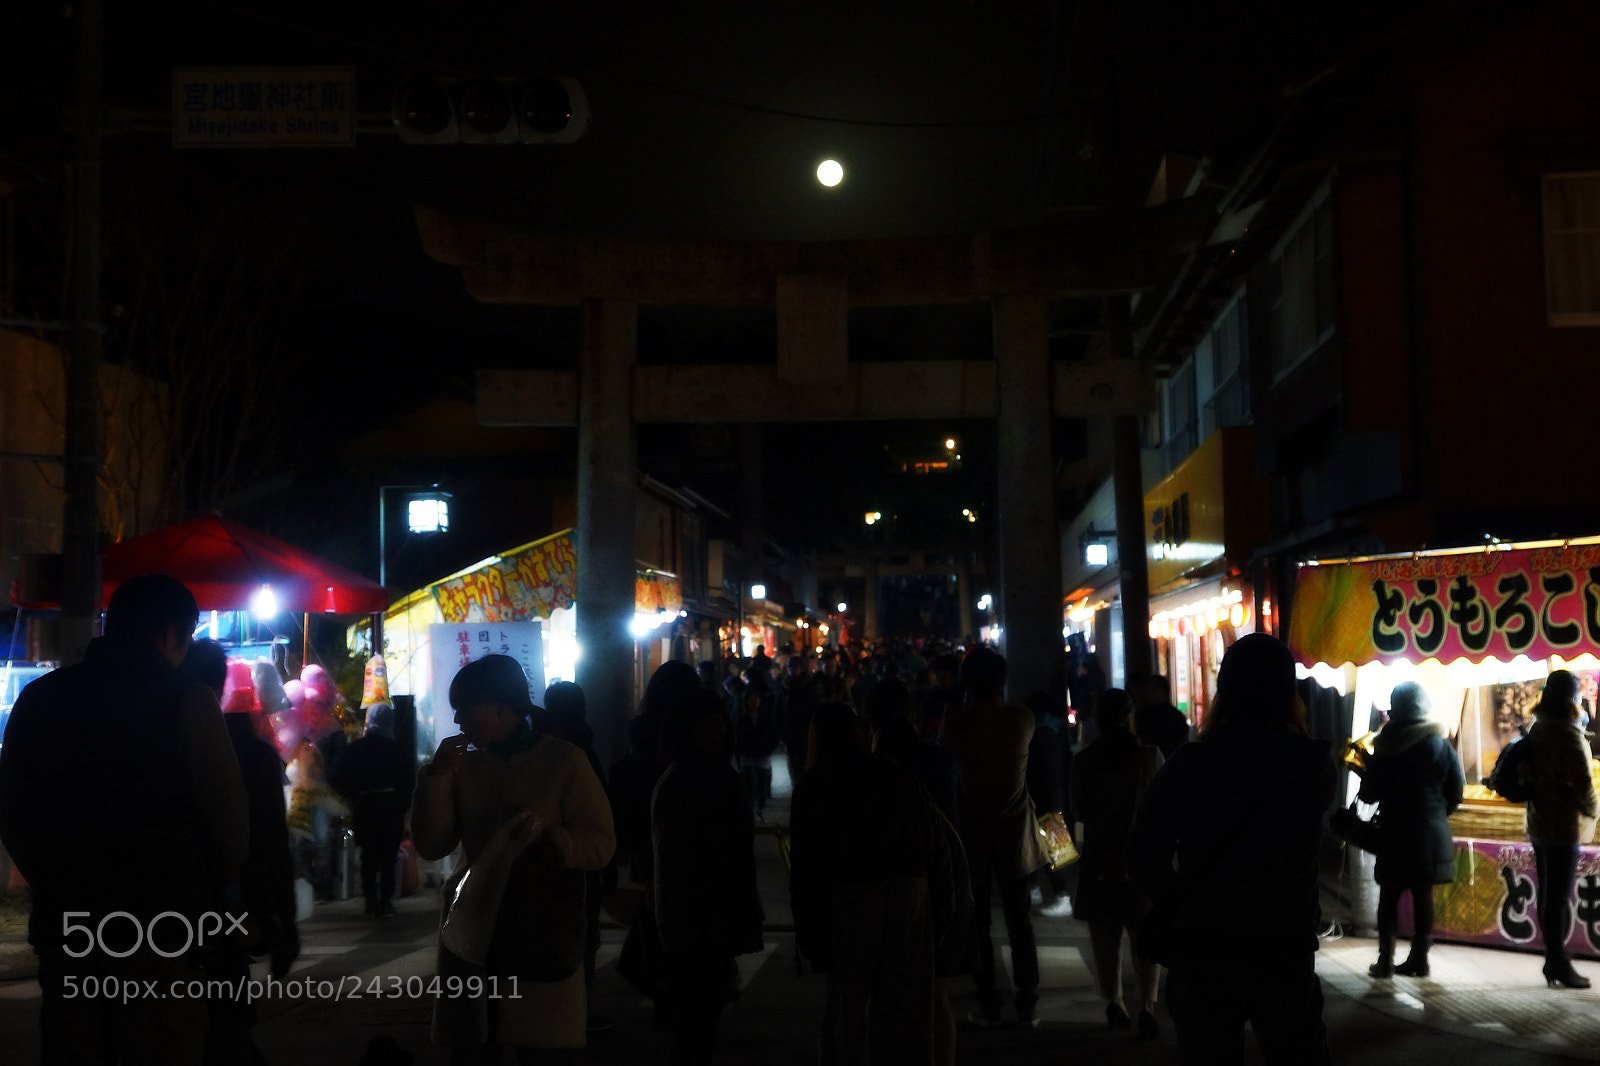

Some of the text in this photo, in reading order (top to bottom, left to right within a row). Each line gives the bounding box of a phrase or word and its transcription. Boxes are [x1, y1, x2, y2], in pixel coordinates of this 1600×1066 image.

[183, 82, 345, 111] 宮地嶽神社前
[188, 118, 340, 137] Miyajidake Shrine
